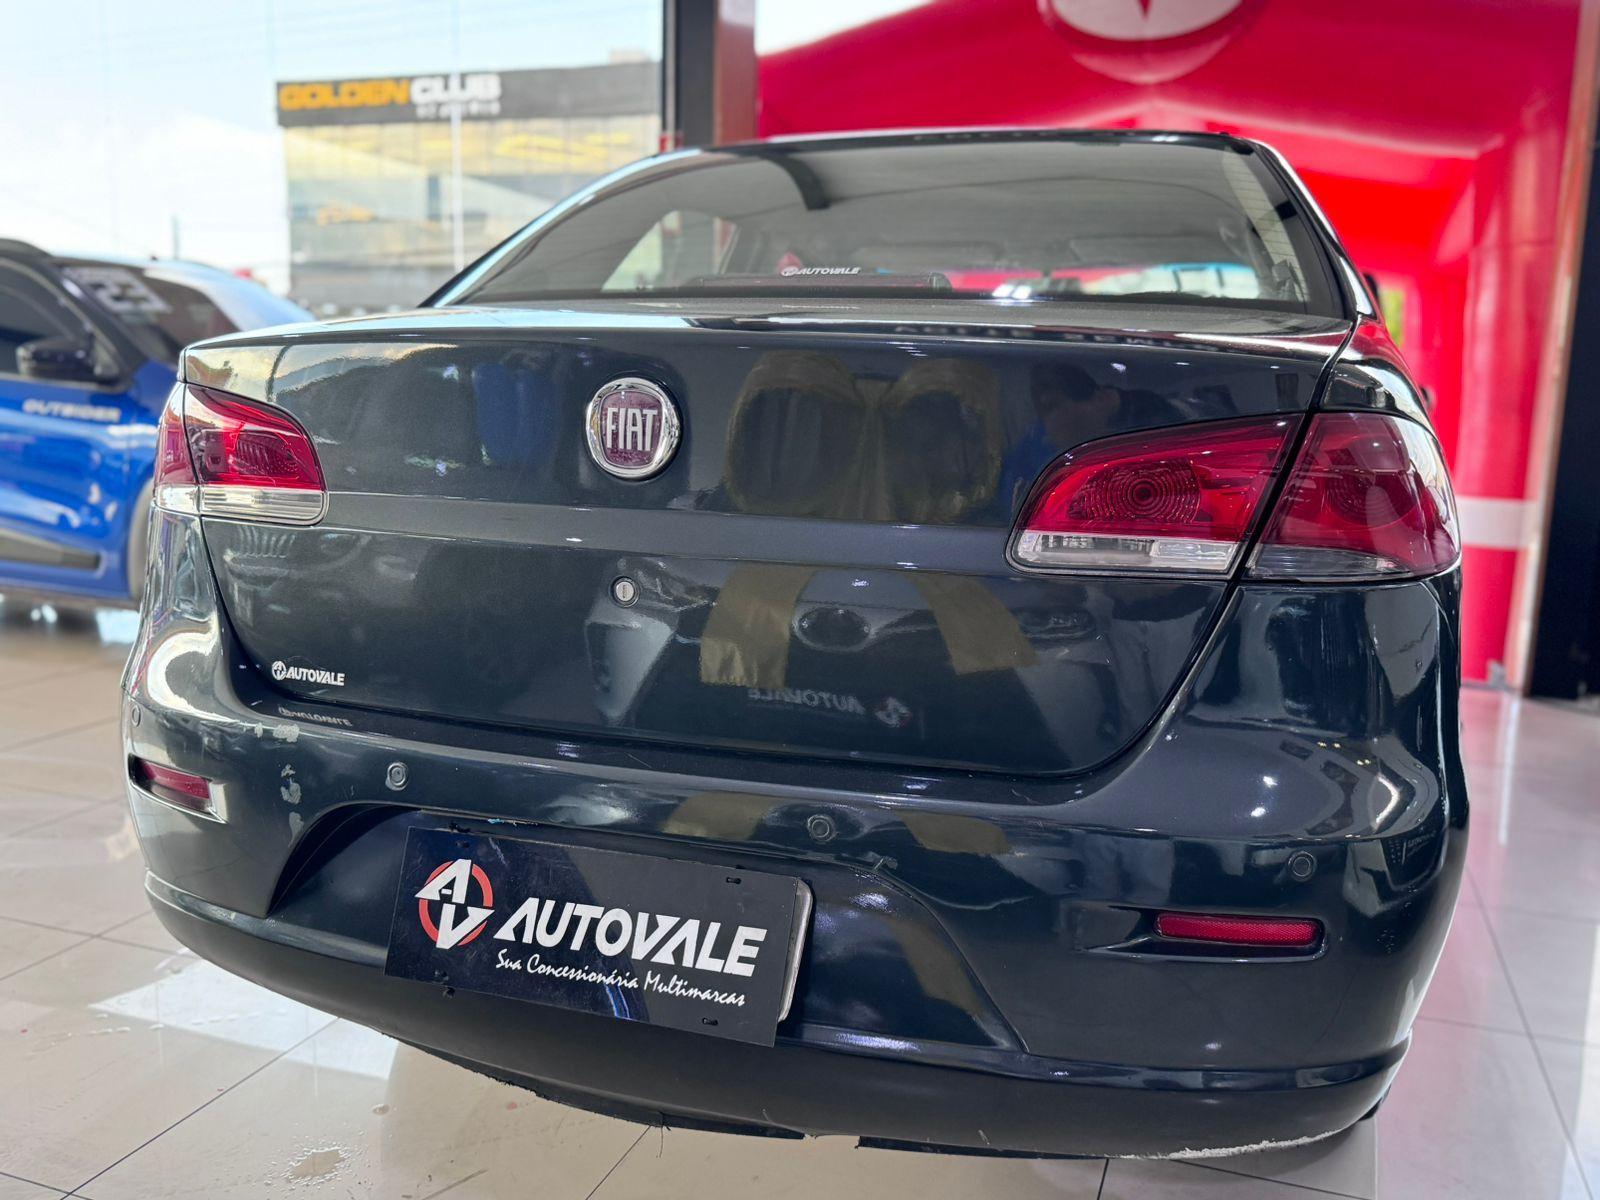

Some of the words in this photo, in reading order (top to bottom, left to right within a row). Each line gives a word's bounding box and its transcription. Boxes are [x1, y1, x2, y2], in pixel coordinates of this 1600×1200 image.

[279, 78, 410, 111] GOLDEN
[410, 73, 501, 104] CLUB
[795, 267, 861, 275] AUTOVALE
[606, 407, 658, 451] FIAT
[286, 667, 345, 686] AUTOVALE
[493, 897, 768, 977] AUTOVALE
[496, 948, 522, 970] Sua
[526, 953, 639, 989] Concessionária
[643, 971, 746, 1007] Multimarcas
